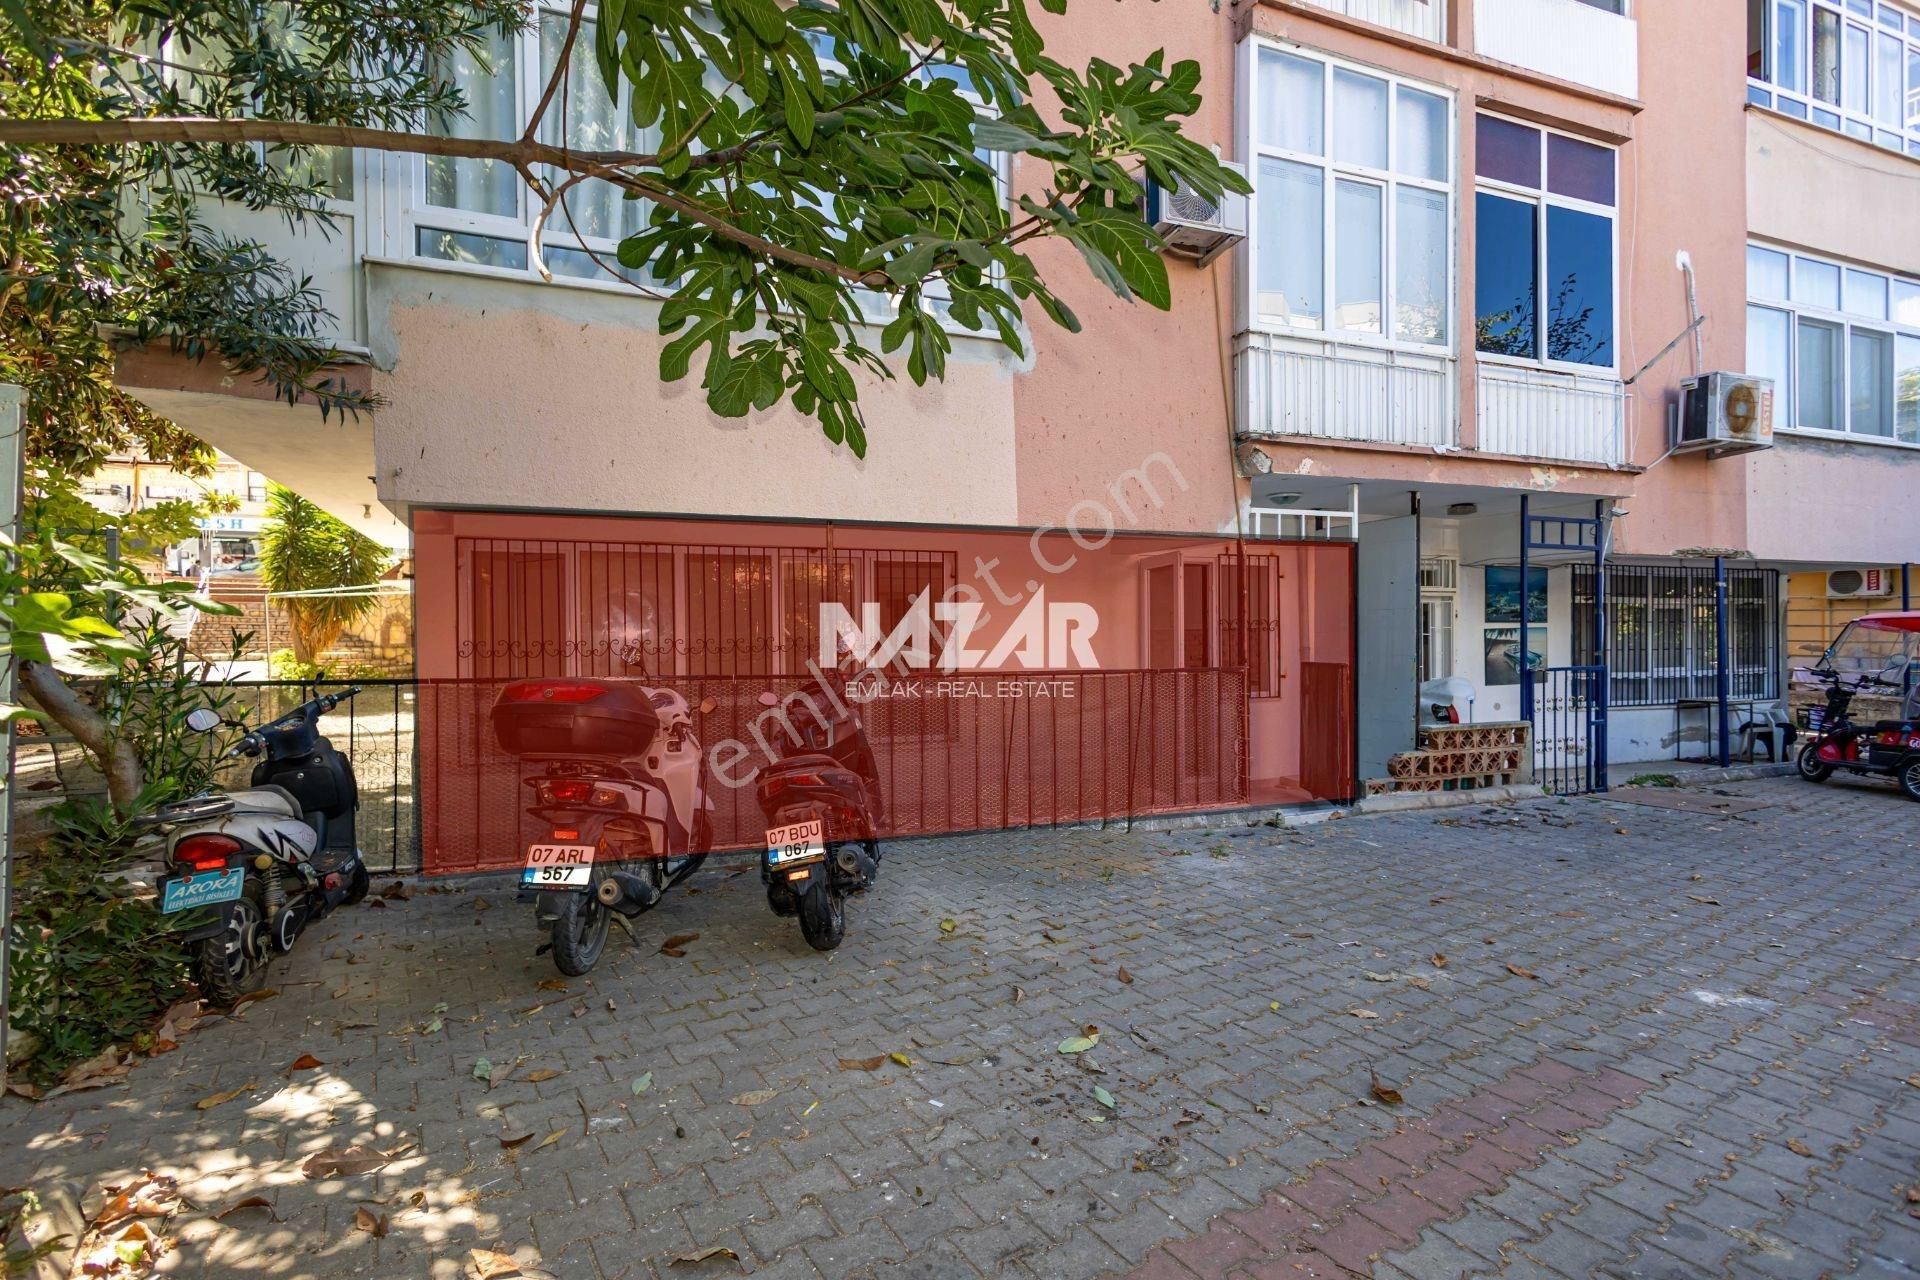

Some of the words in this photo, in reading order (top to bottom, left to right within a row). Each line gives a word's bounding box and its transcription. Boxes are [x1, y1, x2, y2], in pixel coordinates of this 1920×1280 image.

[769, 830, 785, 845] 07
[789, 823, 819, 841] BDU
[532, 848, 553, 862] 07
[555, 849, 589, 864] ARL
[784, 841, 809, 857] 067
[542, 866, 574, 881] 567
[170, 876, 238, 899] ARORA
